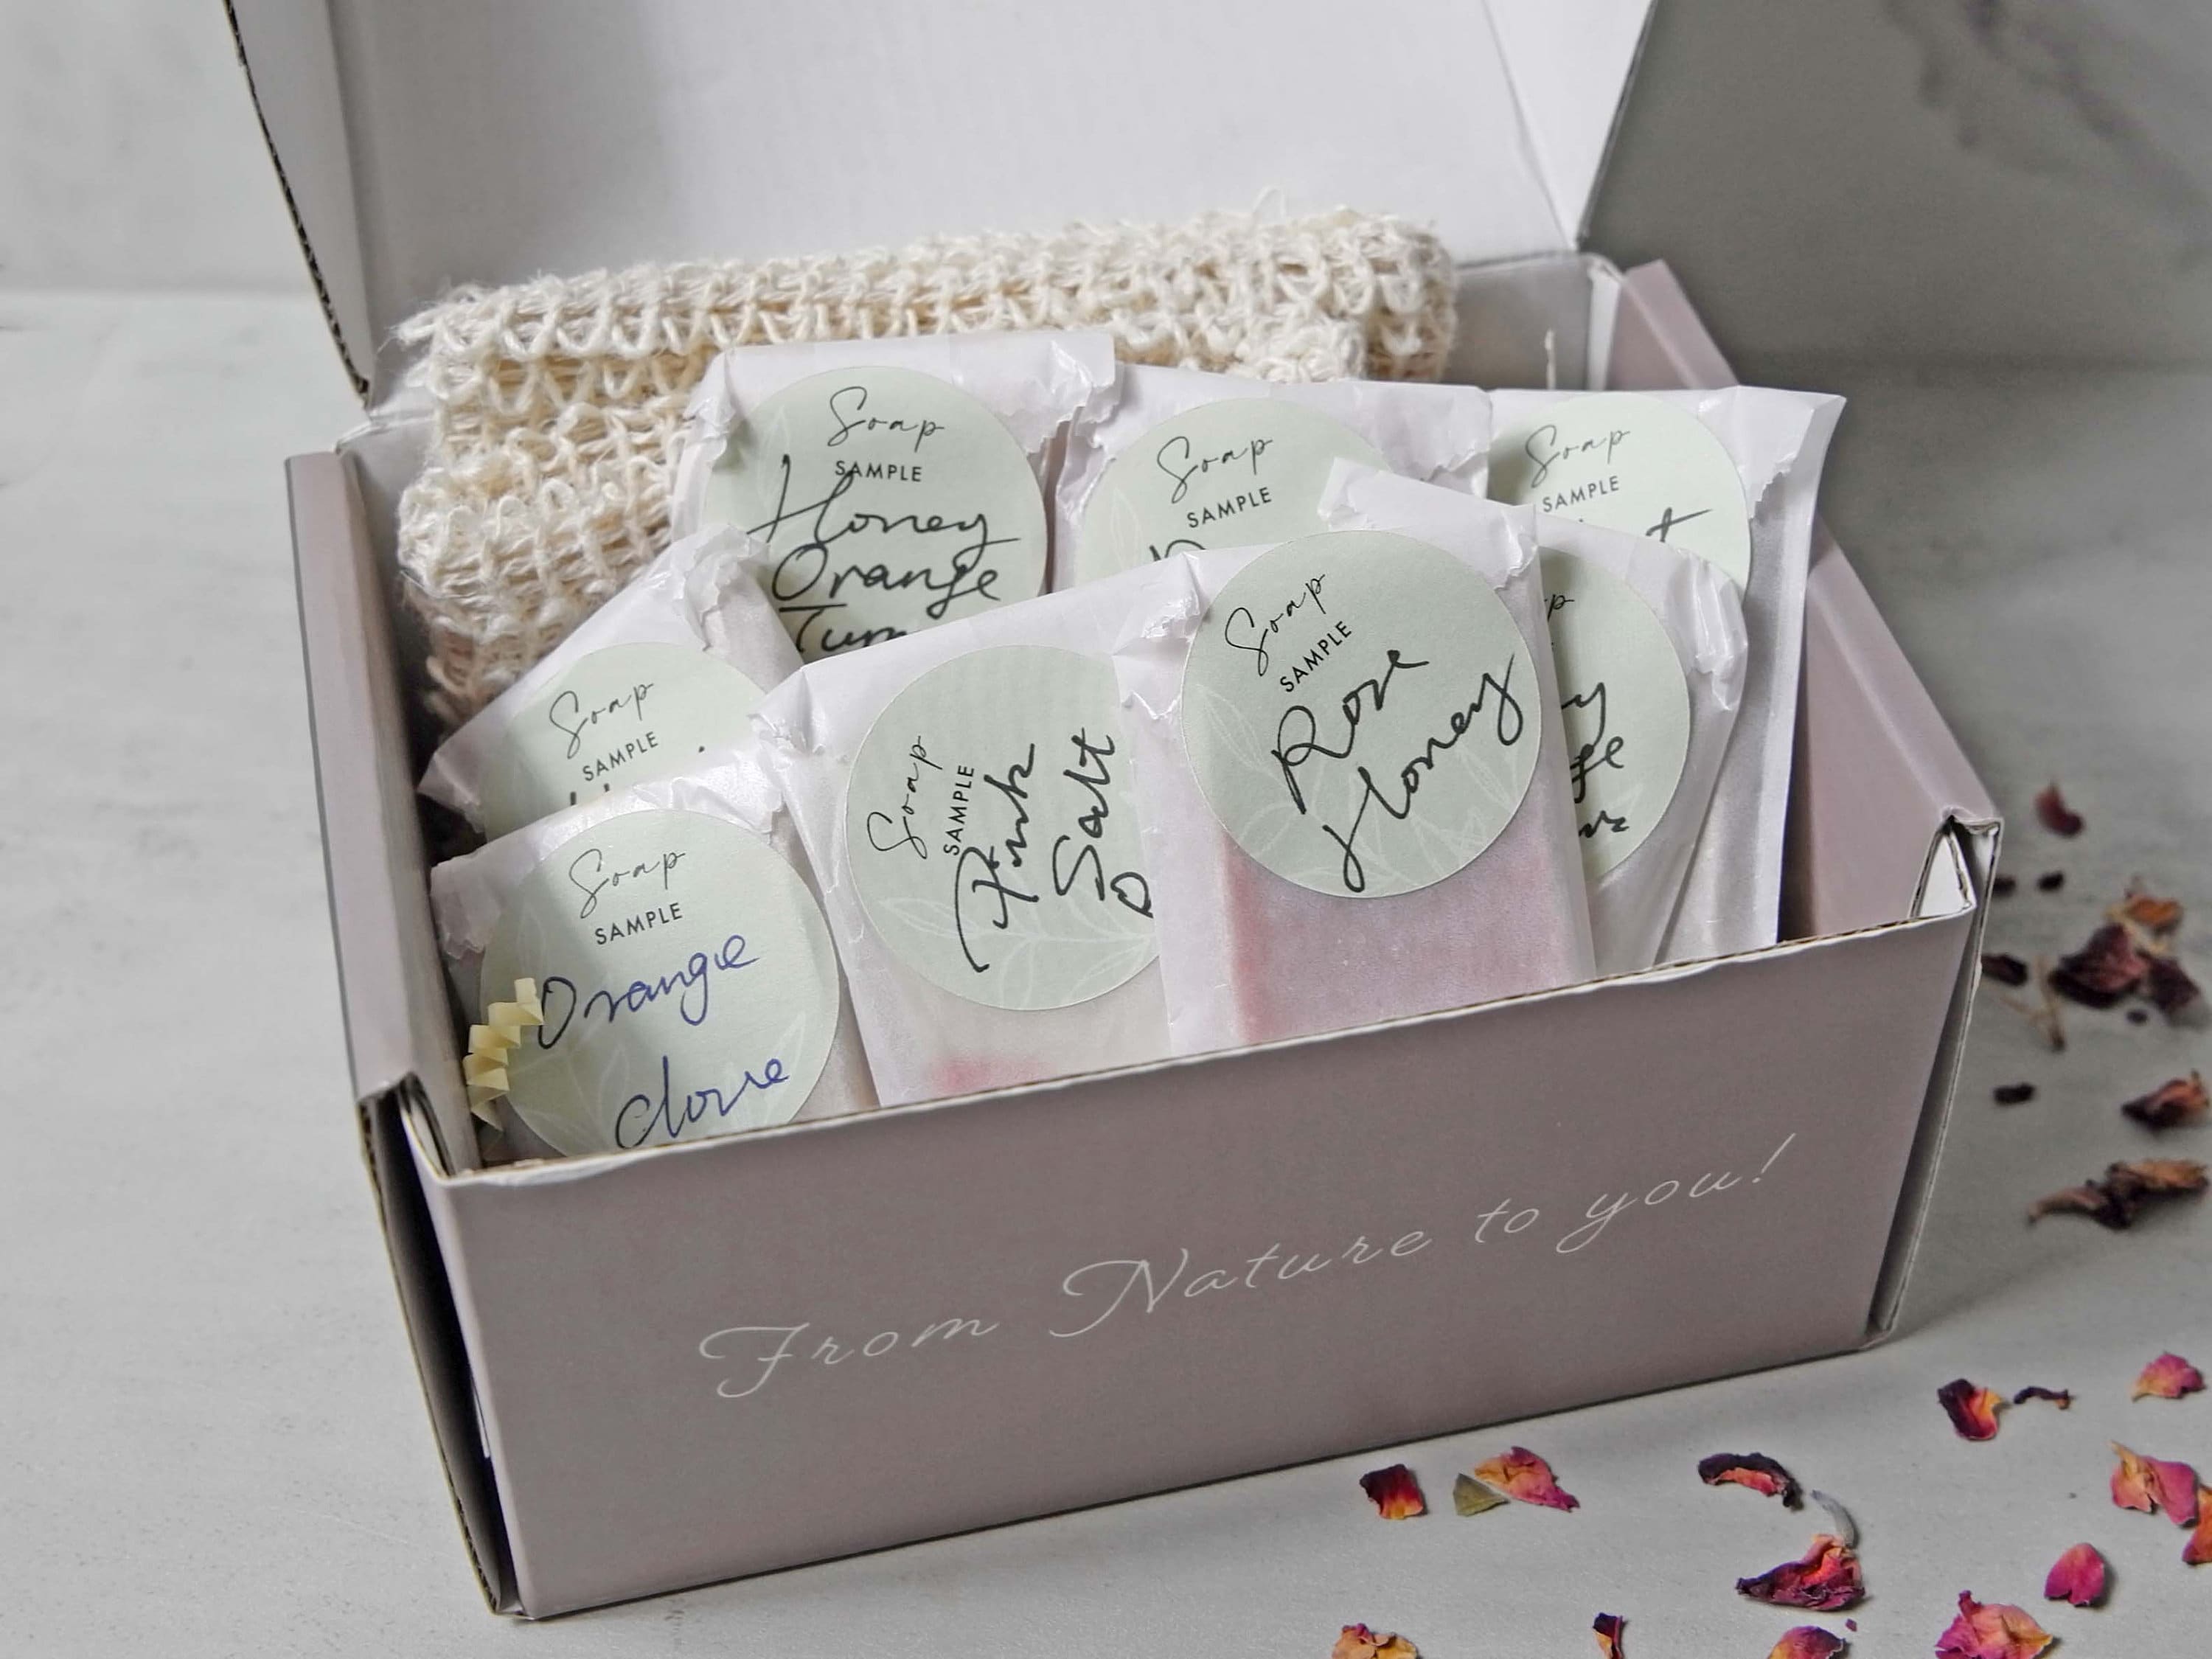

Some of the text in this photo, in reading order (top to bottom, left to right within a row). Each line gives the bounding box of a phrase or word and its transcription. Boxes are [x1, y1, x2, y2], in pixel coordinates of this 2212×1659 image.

[827, 386, 945, 452] Soap
[1526, 424, 1631, 488] Soap
[834, 460, 922, 482] SAMPLE
[1157, 436, 1273, 504] Soap
[1187, 486, 1273, 529] SAMPLE
[1542, 476, 1620, 512] SAMPLE
[747, 453, 1020, 566] Honey
[771, 542, 1001, 619] Orange
[1225, 574, 1326, 676] Soap
[1279, 621, 1352, 693] SAMPLE
[549, 683, 654, 759] Soap
[582, 731, 658, 782] SAMPLE
[1271, 649, 1430, 815] Rose
[866, 734, 943, 860] Soap
[942, 765, 975, 856] SAMPLE
[1322, 653, 1523, 893] Honey
[1052, 727, 1116, 902] Salt
[568, 848, 686, 919] Soap
[956, 742, 1040, 973] Pink
[594, 902, 683, 946] SAMPLE
[537, 935, 760, 1050] Orange
[699, 1132, 1797, 1399] From Nature to you!
